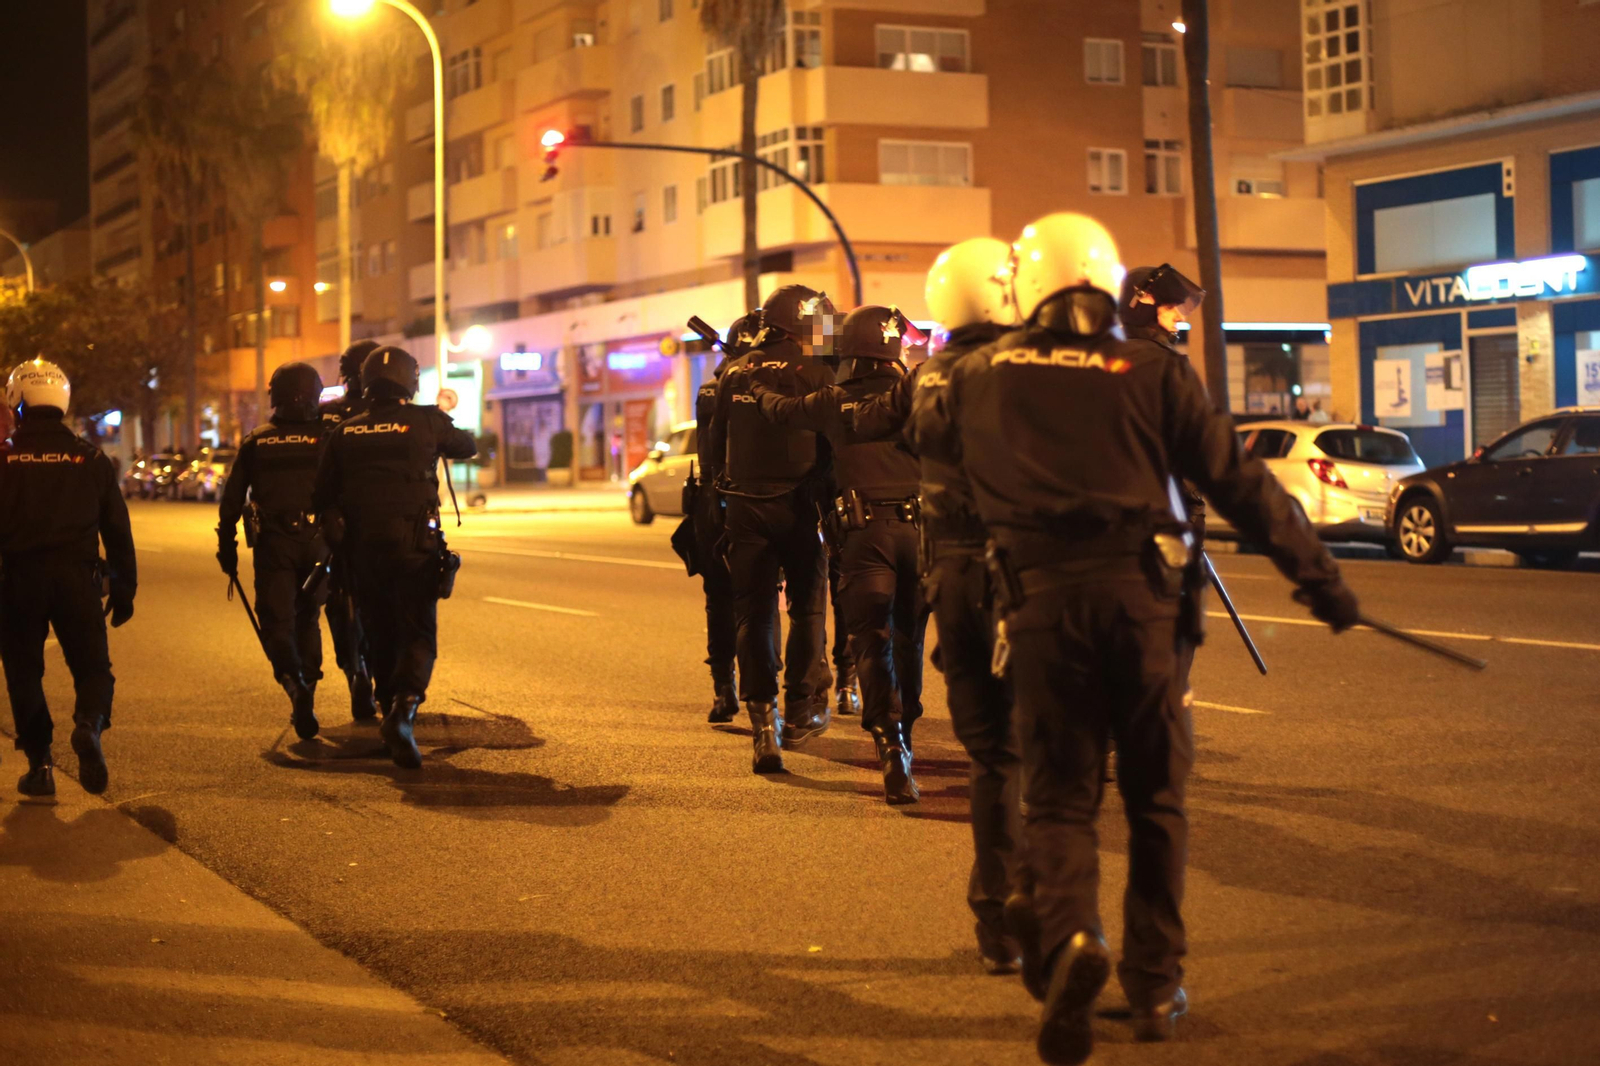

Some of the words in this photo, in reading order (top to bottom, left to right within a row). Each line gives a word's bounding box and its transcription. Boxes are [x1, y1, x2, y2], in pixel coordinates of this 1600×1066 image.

[990, 348, 1105, 369] POLICIA
[343, 423, 401, 435] POLICIA
[257, 435, 310, 446] POLICIA
[6, 453, 72, 463] POLICIA
